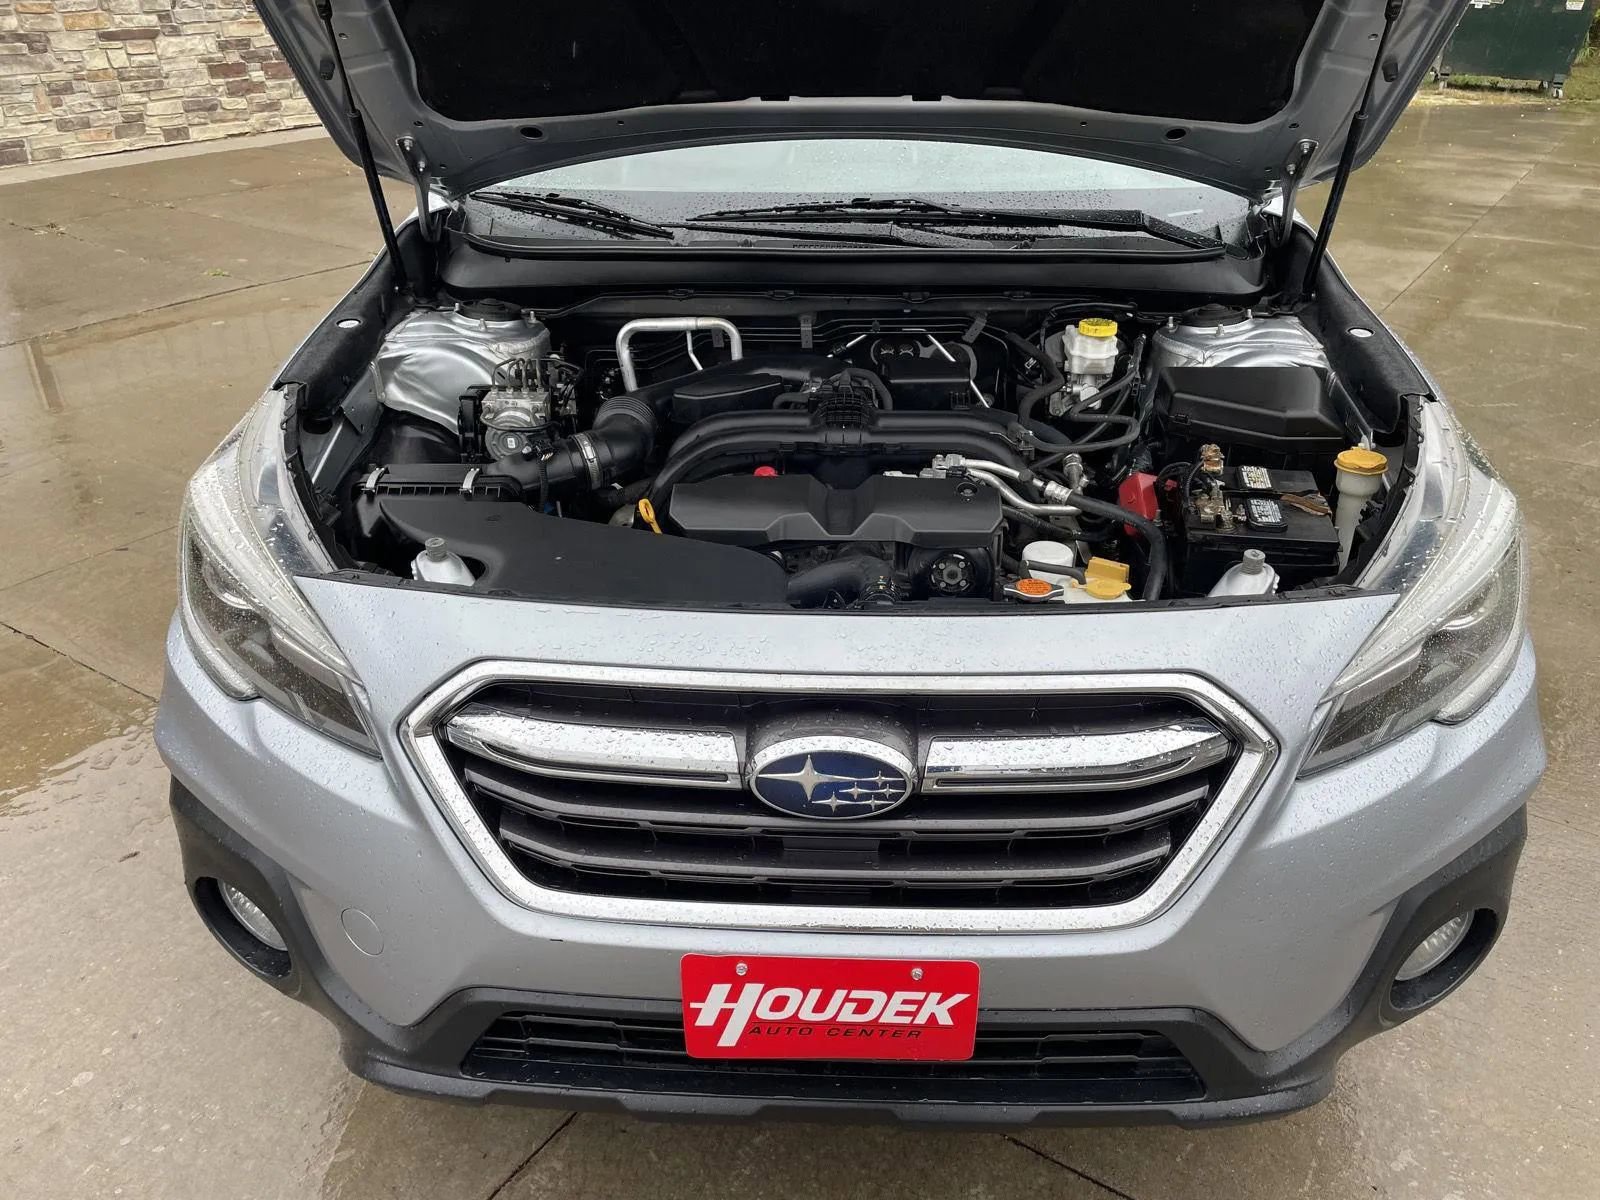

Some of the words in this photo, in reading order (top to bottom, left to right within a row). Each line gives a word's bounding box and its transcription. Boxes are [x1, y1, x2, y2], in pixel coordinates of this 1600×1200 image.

[690, 983, 971, 1047] HOUDEK
[749, 1026, 812, 1036] AUTO
[827, 1027, 922, 1039] CENTER
